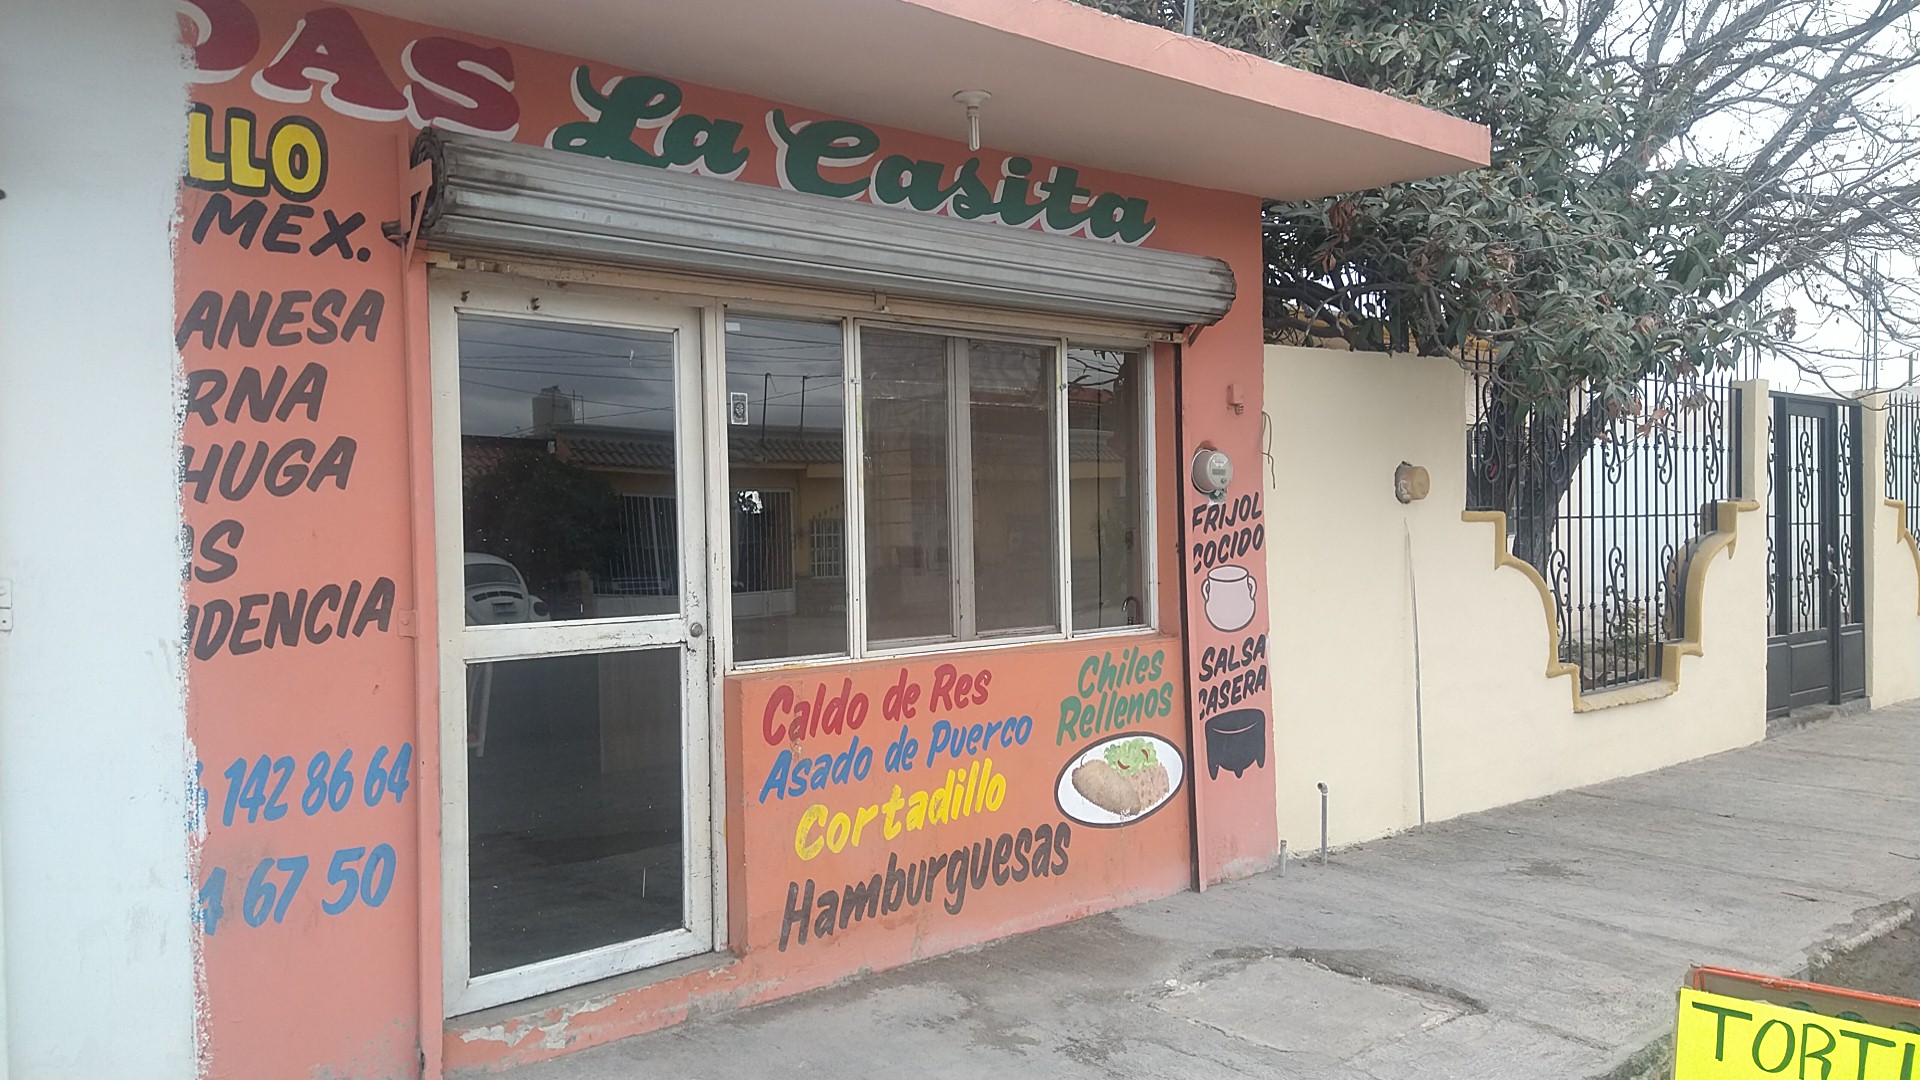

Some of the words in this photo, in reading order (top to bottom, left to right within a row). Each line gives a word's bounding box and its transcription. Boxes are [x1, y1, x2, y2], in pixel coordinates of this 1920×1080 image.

[184, 102, 329, 203] LLO
[545, 65, 750, 182] La
[765, 108, 1156, 245] Casita
[192, 193, 371, 262] MEX.
[175, 289, 385, 350] ANESA
[184, 362, 328, 426] RNA
[182, 436, 358, 505] HUGA
[1192, 491, 1262, 534] FRIJOL
[1077, 645, 1165, 699] Chiles
[1199, 633, 1266, 682] SALSA
[762, 677, 869, 746] Caldo
[883, 668, 921, 722] de
[929, 663, 993, 713] Res
[1056, 681, 1174, 747] Rellenos
[759, 735, 874, 804] Asado
[884, 724, 919, 773] de
[926, 715, 1033, 769] Puerco
[795, 757, 1007, 862] Cortadillo
[243, 854, 309, 928] 67
[321, 843, 396, 915] 50
[778, 821, 1071, 952] Hamburguesas
[1691, 1001, 1916, 1080] TORTI
